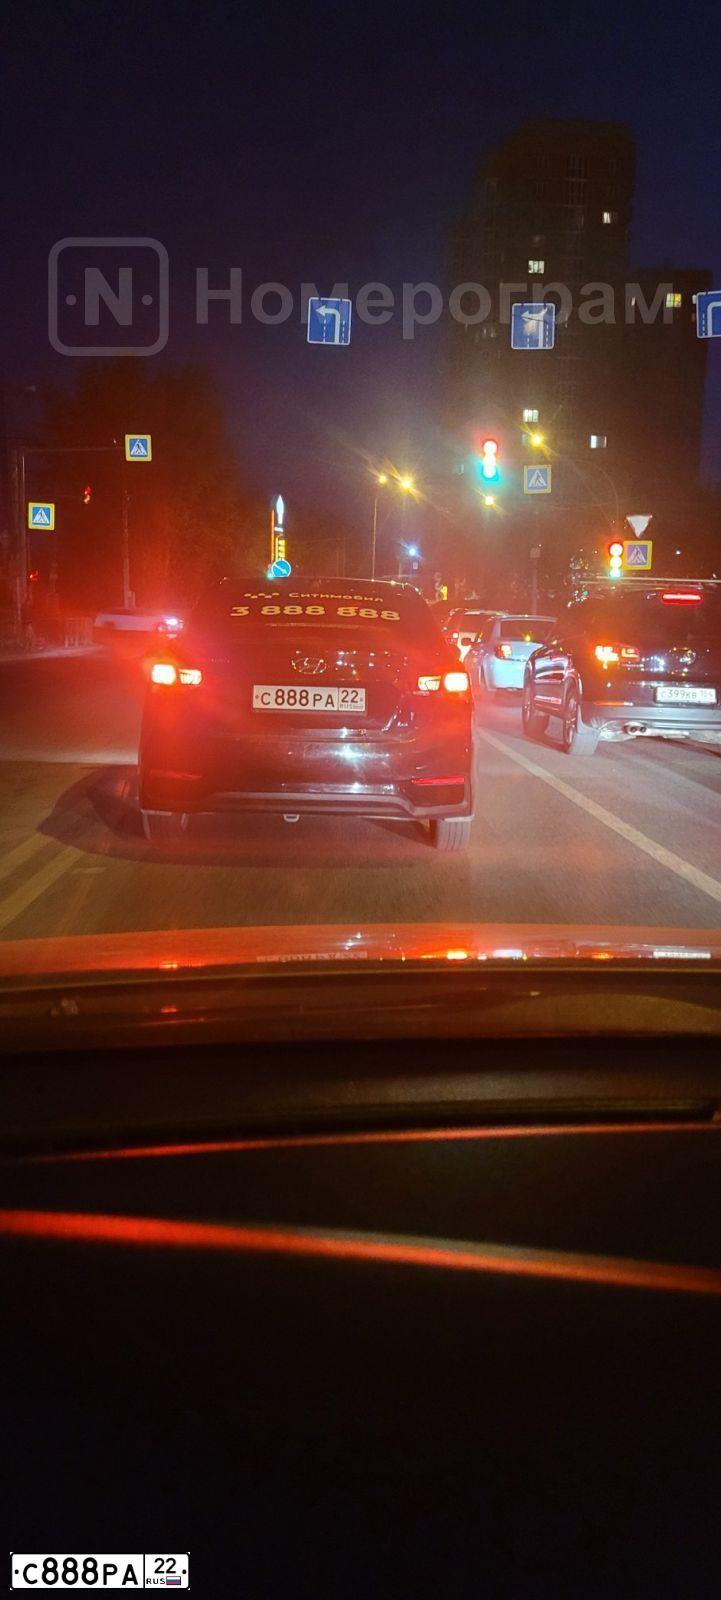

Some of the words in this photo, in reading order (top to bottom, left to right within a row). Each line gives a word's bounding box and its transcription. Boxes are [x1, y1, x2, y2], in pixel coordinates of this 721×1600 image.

[288, 592, 384, 602] Ситимобил
[230, 606, 250, 617] 3
[260, 605, 326, 616] 888
[336, 606, 401, 621] 888
[341, 689, 359, 704] 22
